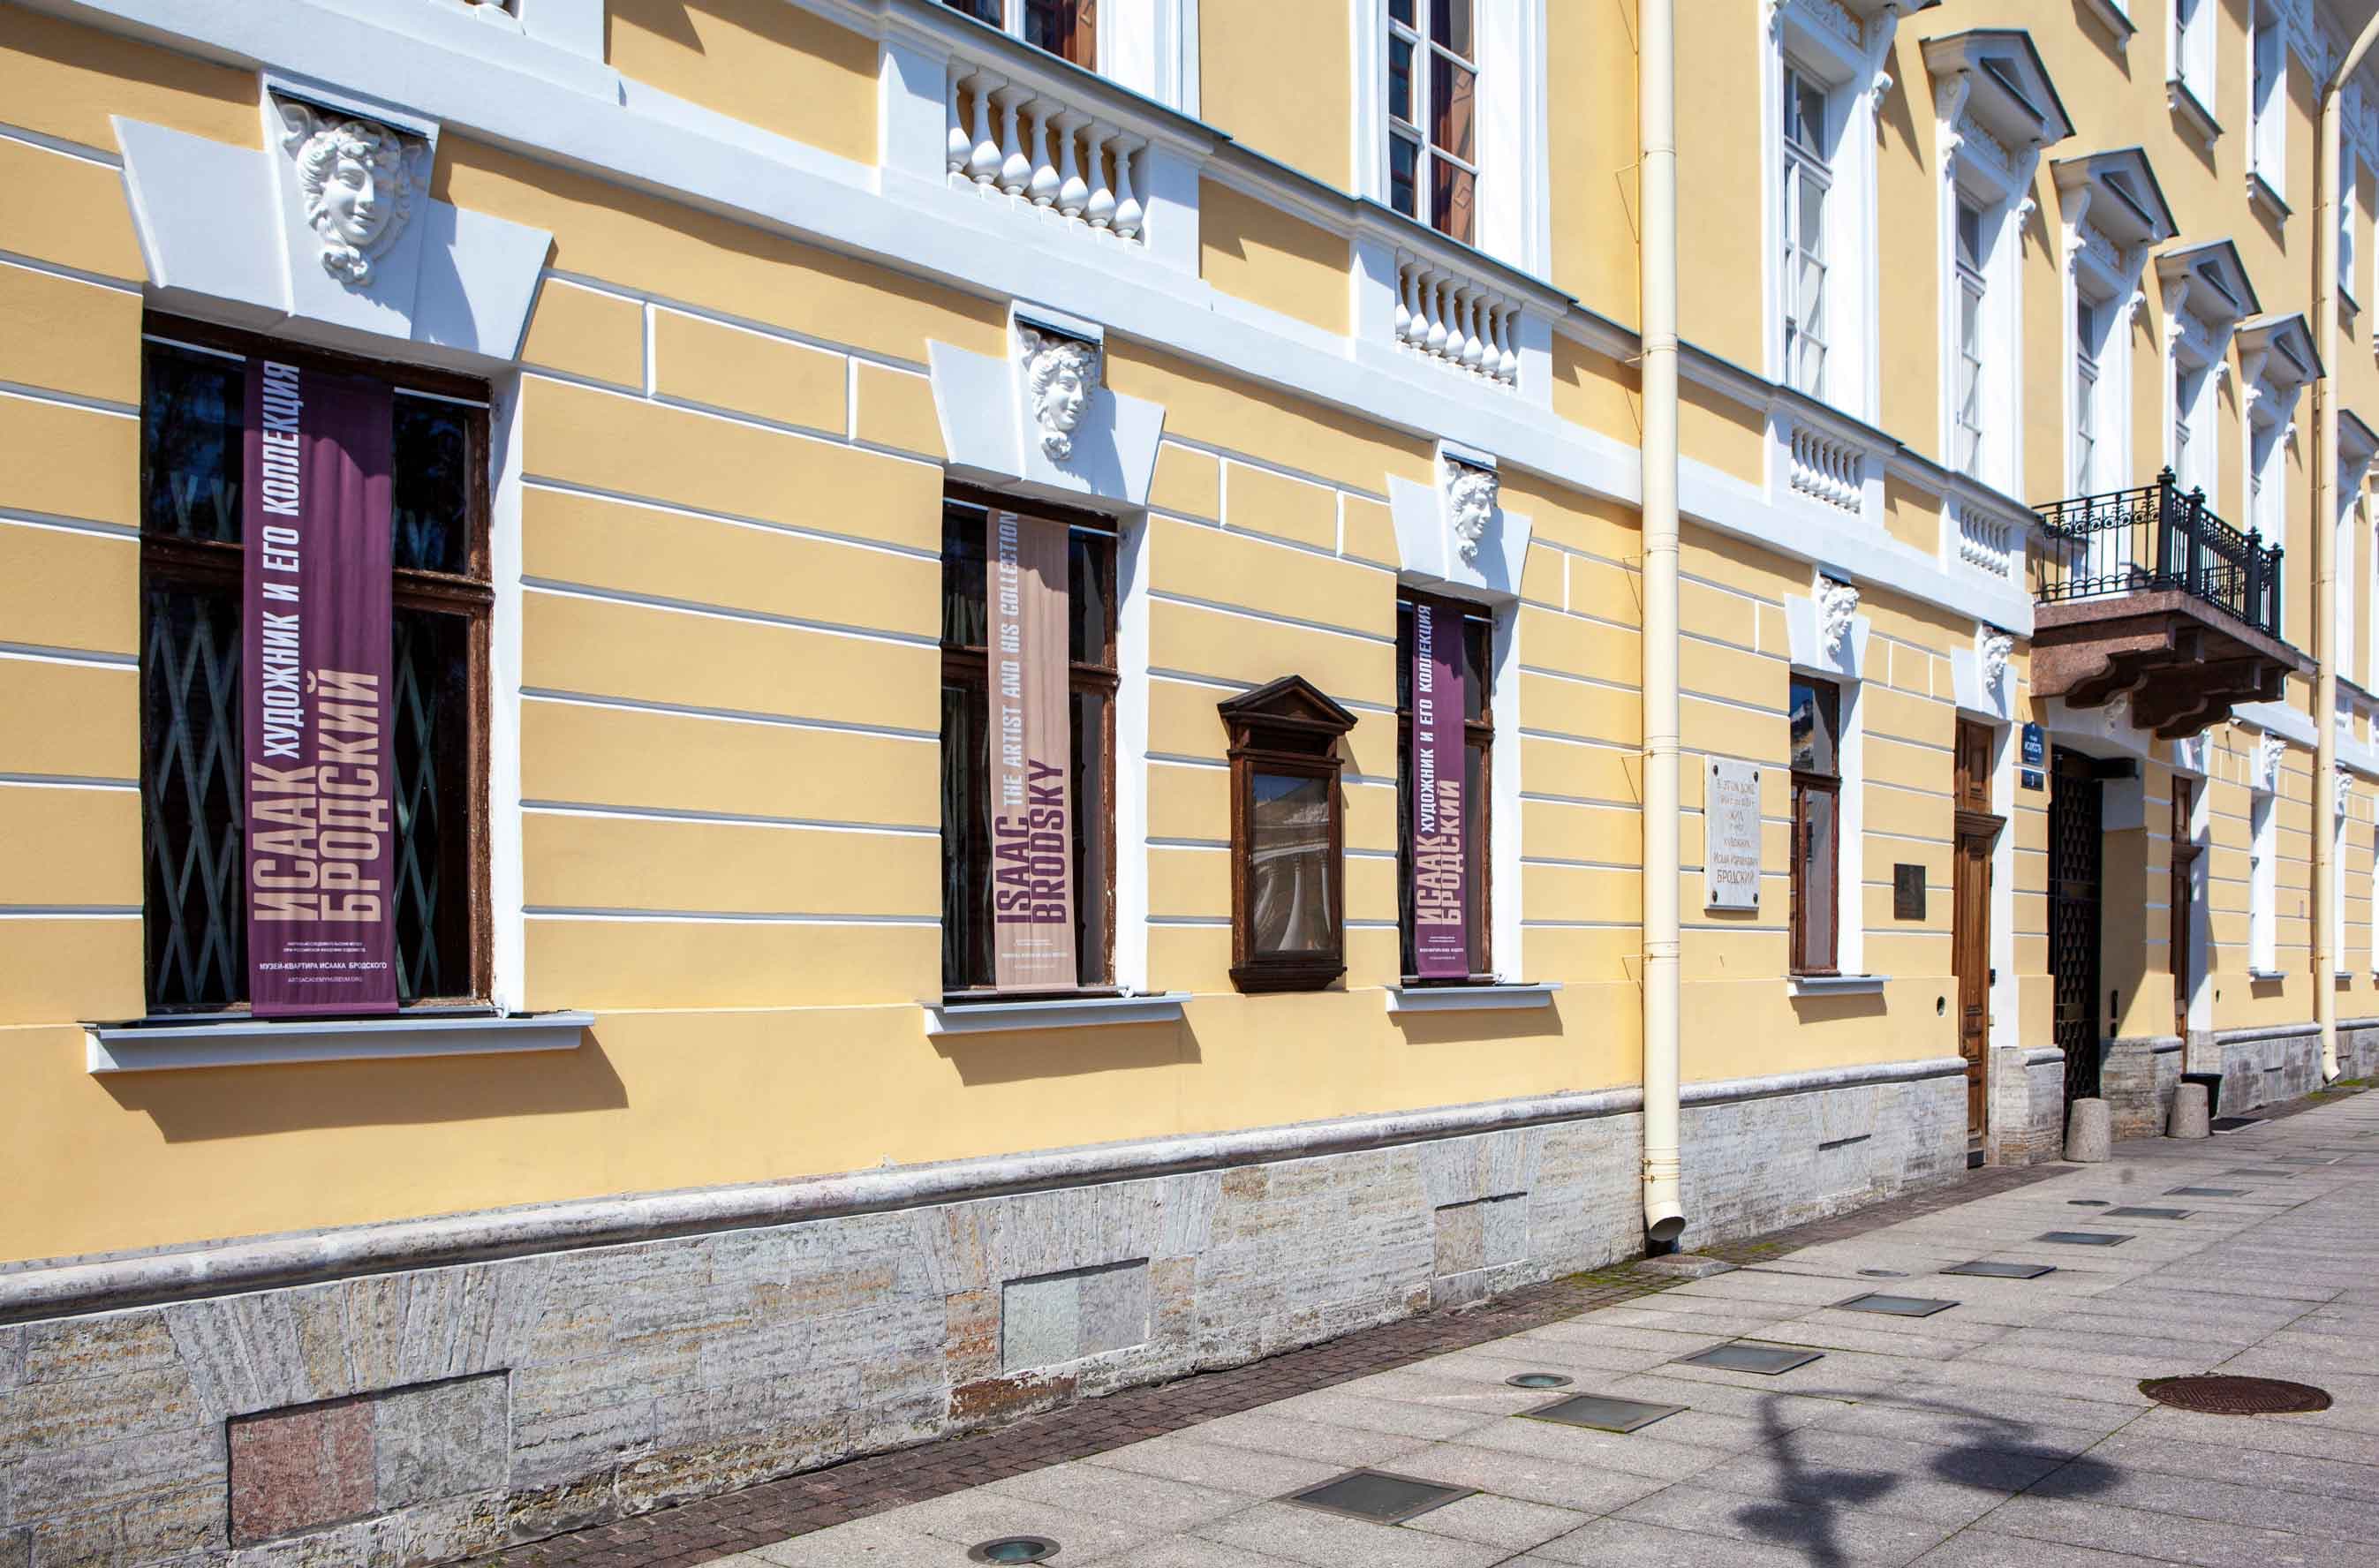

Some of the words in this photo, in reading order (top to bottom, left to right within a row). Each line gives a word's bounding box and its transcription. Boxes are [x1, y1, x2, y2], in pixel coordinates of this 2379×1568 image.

[263, 360, 304, 516] КОЛЛЕКЦИЯ
[263, 525, 299, 572] ЕГО
[999, 511, 1019, 616] COLLECTION
[263, 583, 299, 601] И
[1001, 624, 1020, 653] HIS
[1002, 660, 1021, 698] AND
[1418, 604, 1433, 693] КОЛЛЕКЦИЯ
[263, 612, 304, 759] ХУДОЖНИК
[1419, 698, 1433, 725] ЕГО
[1002, 705, 1022, 767] ARTIST
[1420, 732, 1434, 743] И
[307, 669, 389, 922] БРОДСКИЙ
[1003, 775, 1023, 805] THE
[1420, 749, 1436, 833] ХУДОЖНИК
[251, 762, 318, 921] ИСААК
[995, 816, 1032, 923] ISAAC
[1028, 759, 1067, 923] BRODSKY
[1416, 835, 1442, 925] ИСААК
[1437, 780, 1463, 925] БРОДСКИЙ
[1717, 869, 1755, 885] БРОДСКИЙ
[260, 961, 318, 970] МУЗЕЙ-КВАРТИРА
